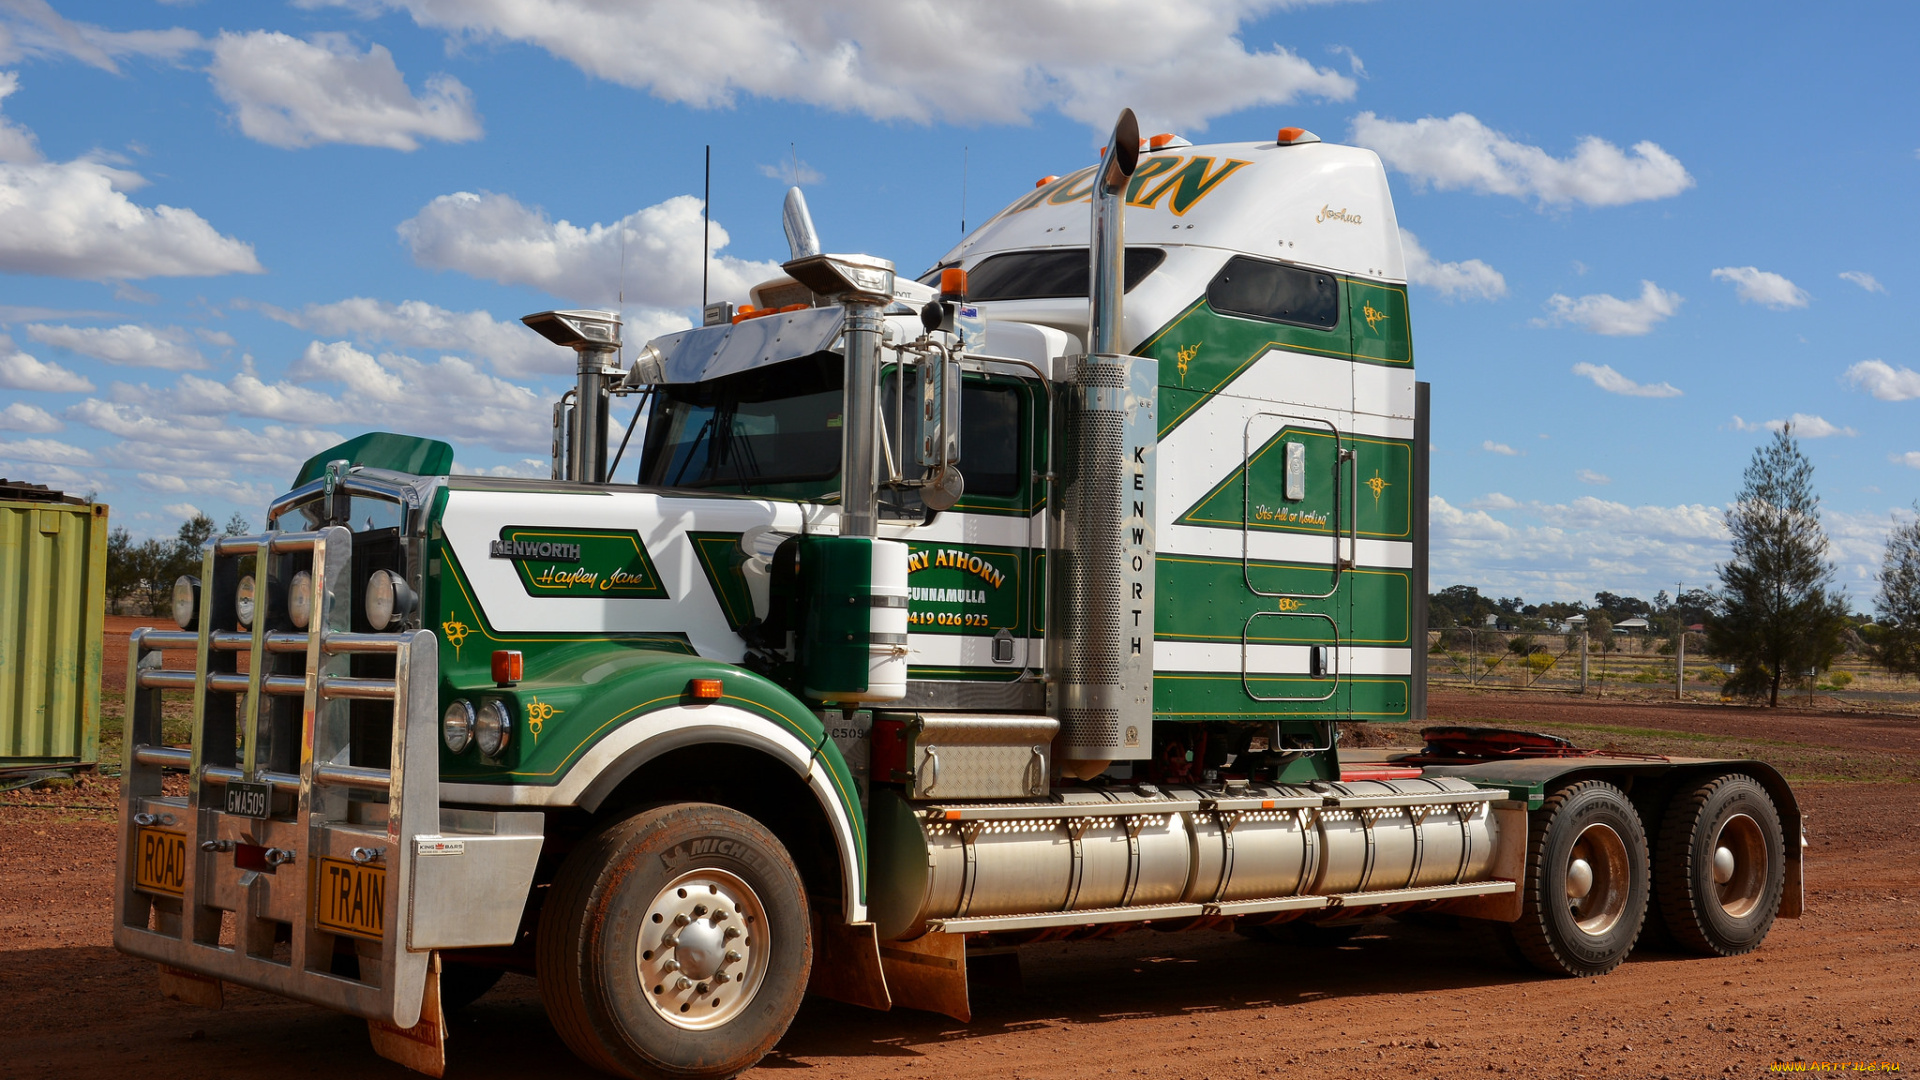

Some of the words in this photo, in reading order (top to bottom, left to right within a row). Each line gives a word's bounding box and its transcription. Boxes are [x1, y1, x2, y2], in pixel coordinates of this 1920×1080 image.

[1315, 204, 1362, 225] Joshua
[1274, 507, 1289, 521] All
[1288, 513, 1298, 523] or
[490, 540, 580, 561] KENWORTH
[1131, 446, 1145, 655] KENWORTH
[536, 565, 598, 589] Hayley
[599, 567, 643, 591] Jane
[935, 548, 1006, 589] ATHORN
[937, 612, 962, 626] 026
[965, 613, 989, 627] 925
[831, 728, 864, 739] C509
[228, 790, 265, 816] GWA509
[1575, 801, 1641, 843] TRIANGLE
[144, 834, 187, 888] ROAD
[329, 866, 386, 931] TRAIN
